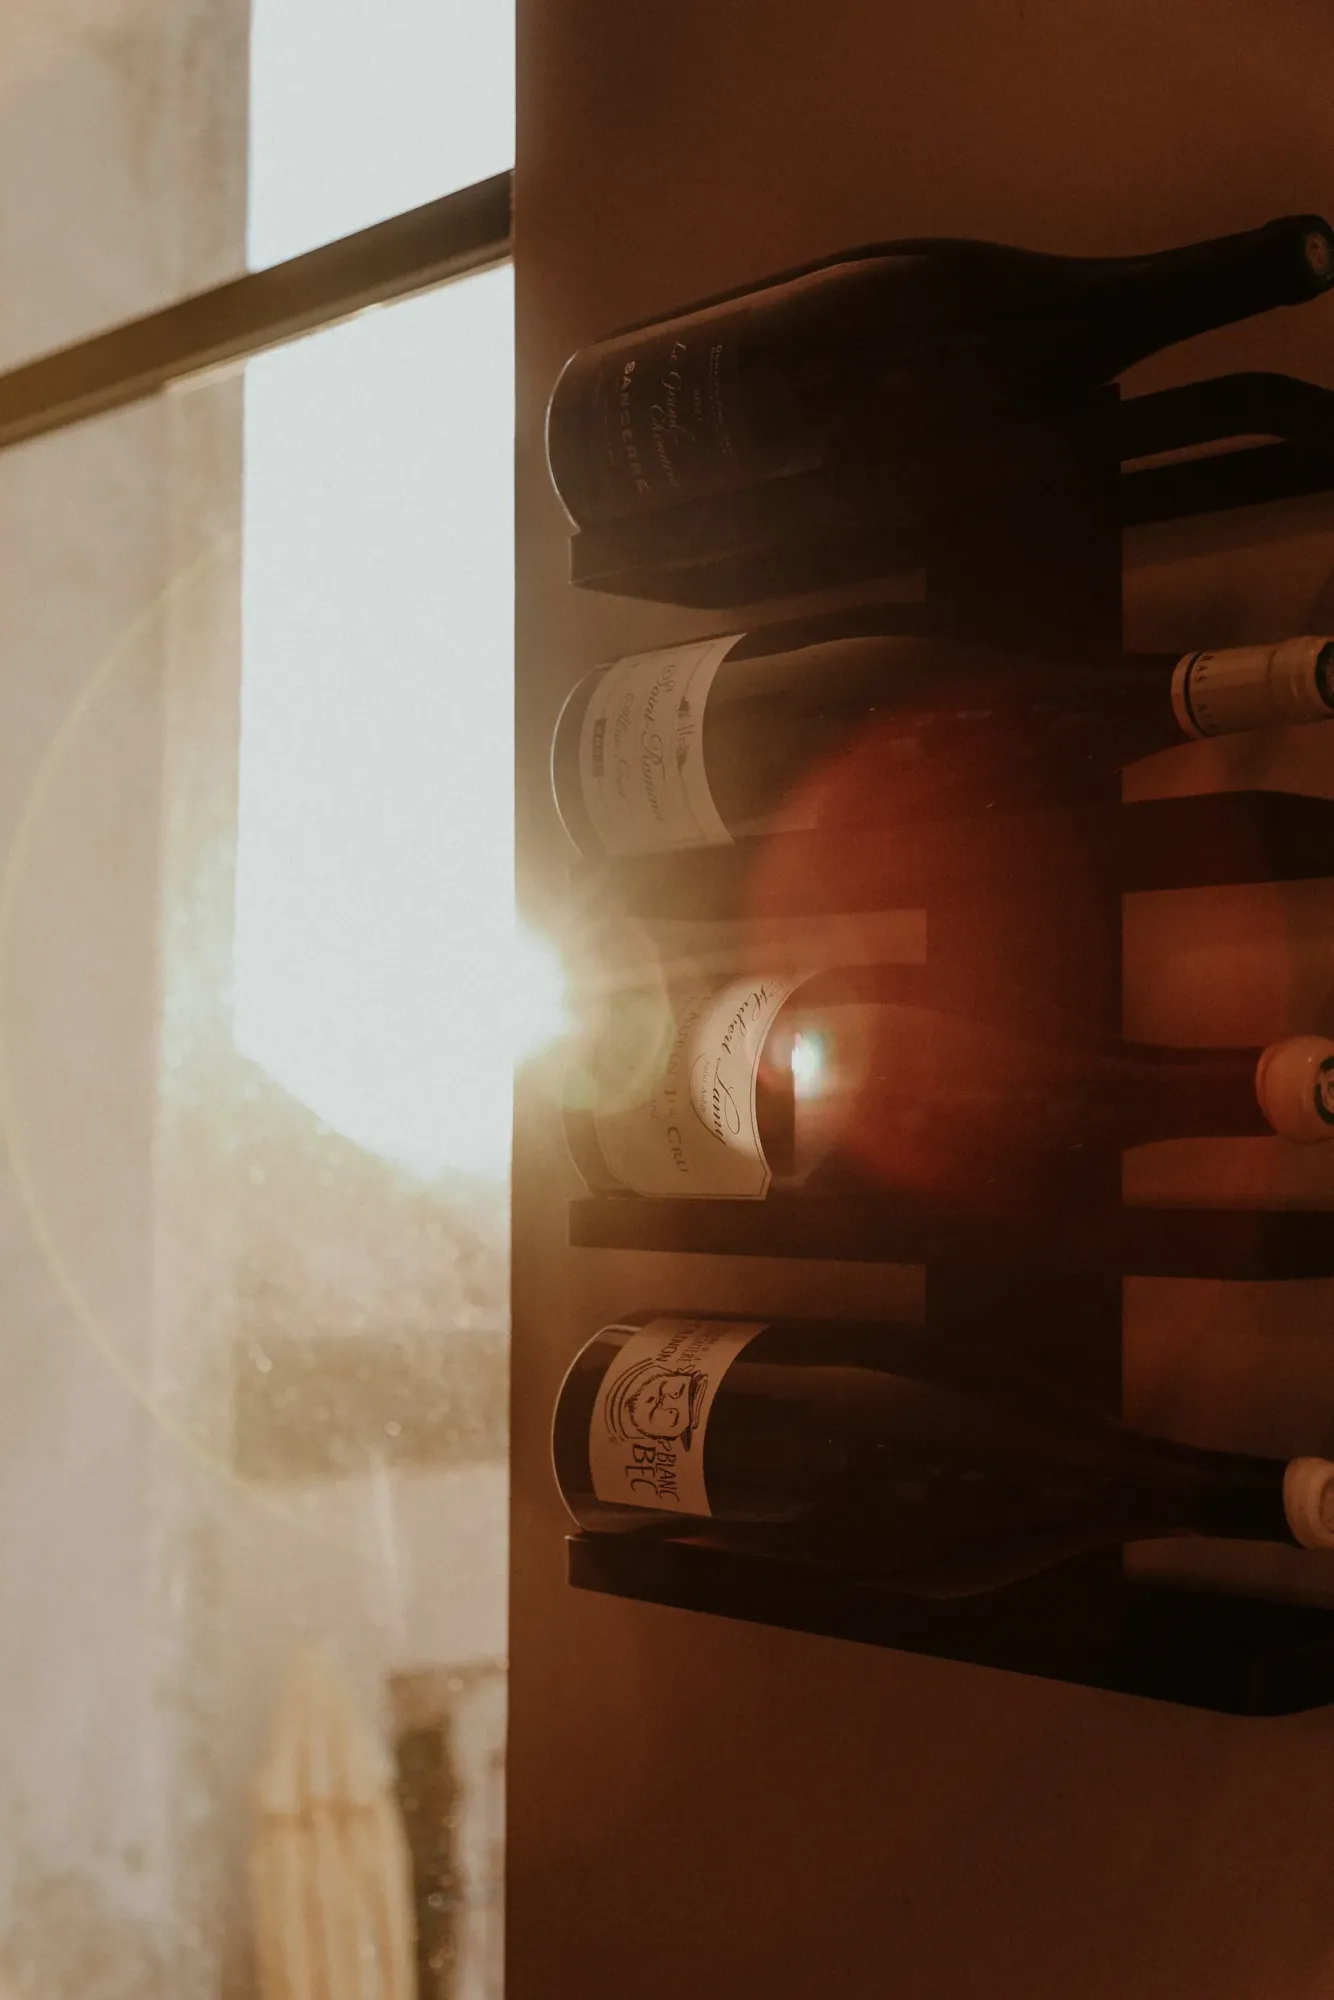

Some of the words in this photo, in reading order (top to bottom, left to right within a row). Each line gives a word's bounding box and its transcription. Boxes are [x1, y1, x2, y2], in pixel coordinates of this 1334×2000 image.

[620, 360, 650, 494] SANCERRE
[640, 664, 678, 823] Saint-Romain
[720, 984, 772, 1054] Hubert
[666, 1125, 689, 1174] CRU
[625, 1443, 658, 1495] BEC
[655, 1452, 681, 1503] BLANC
